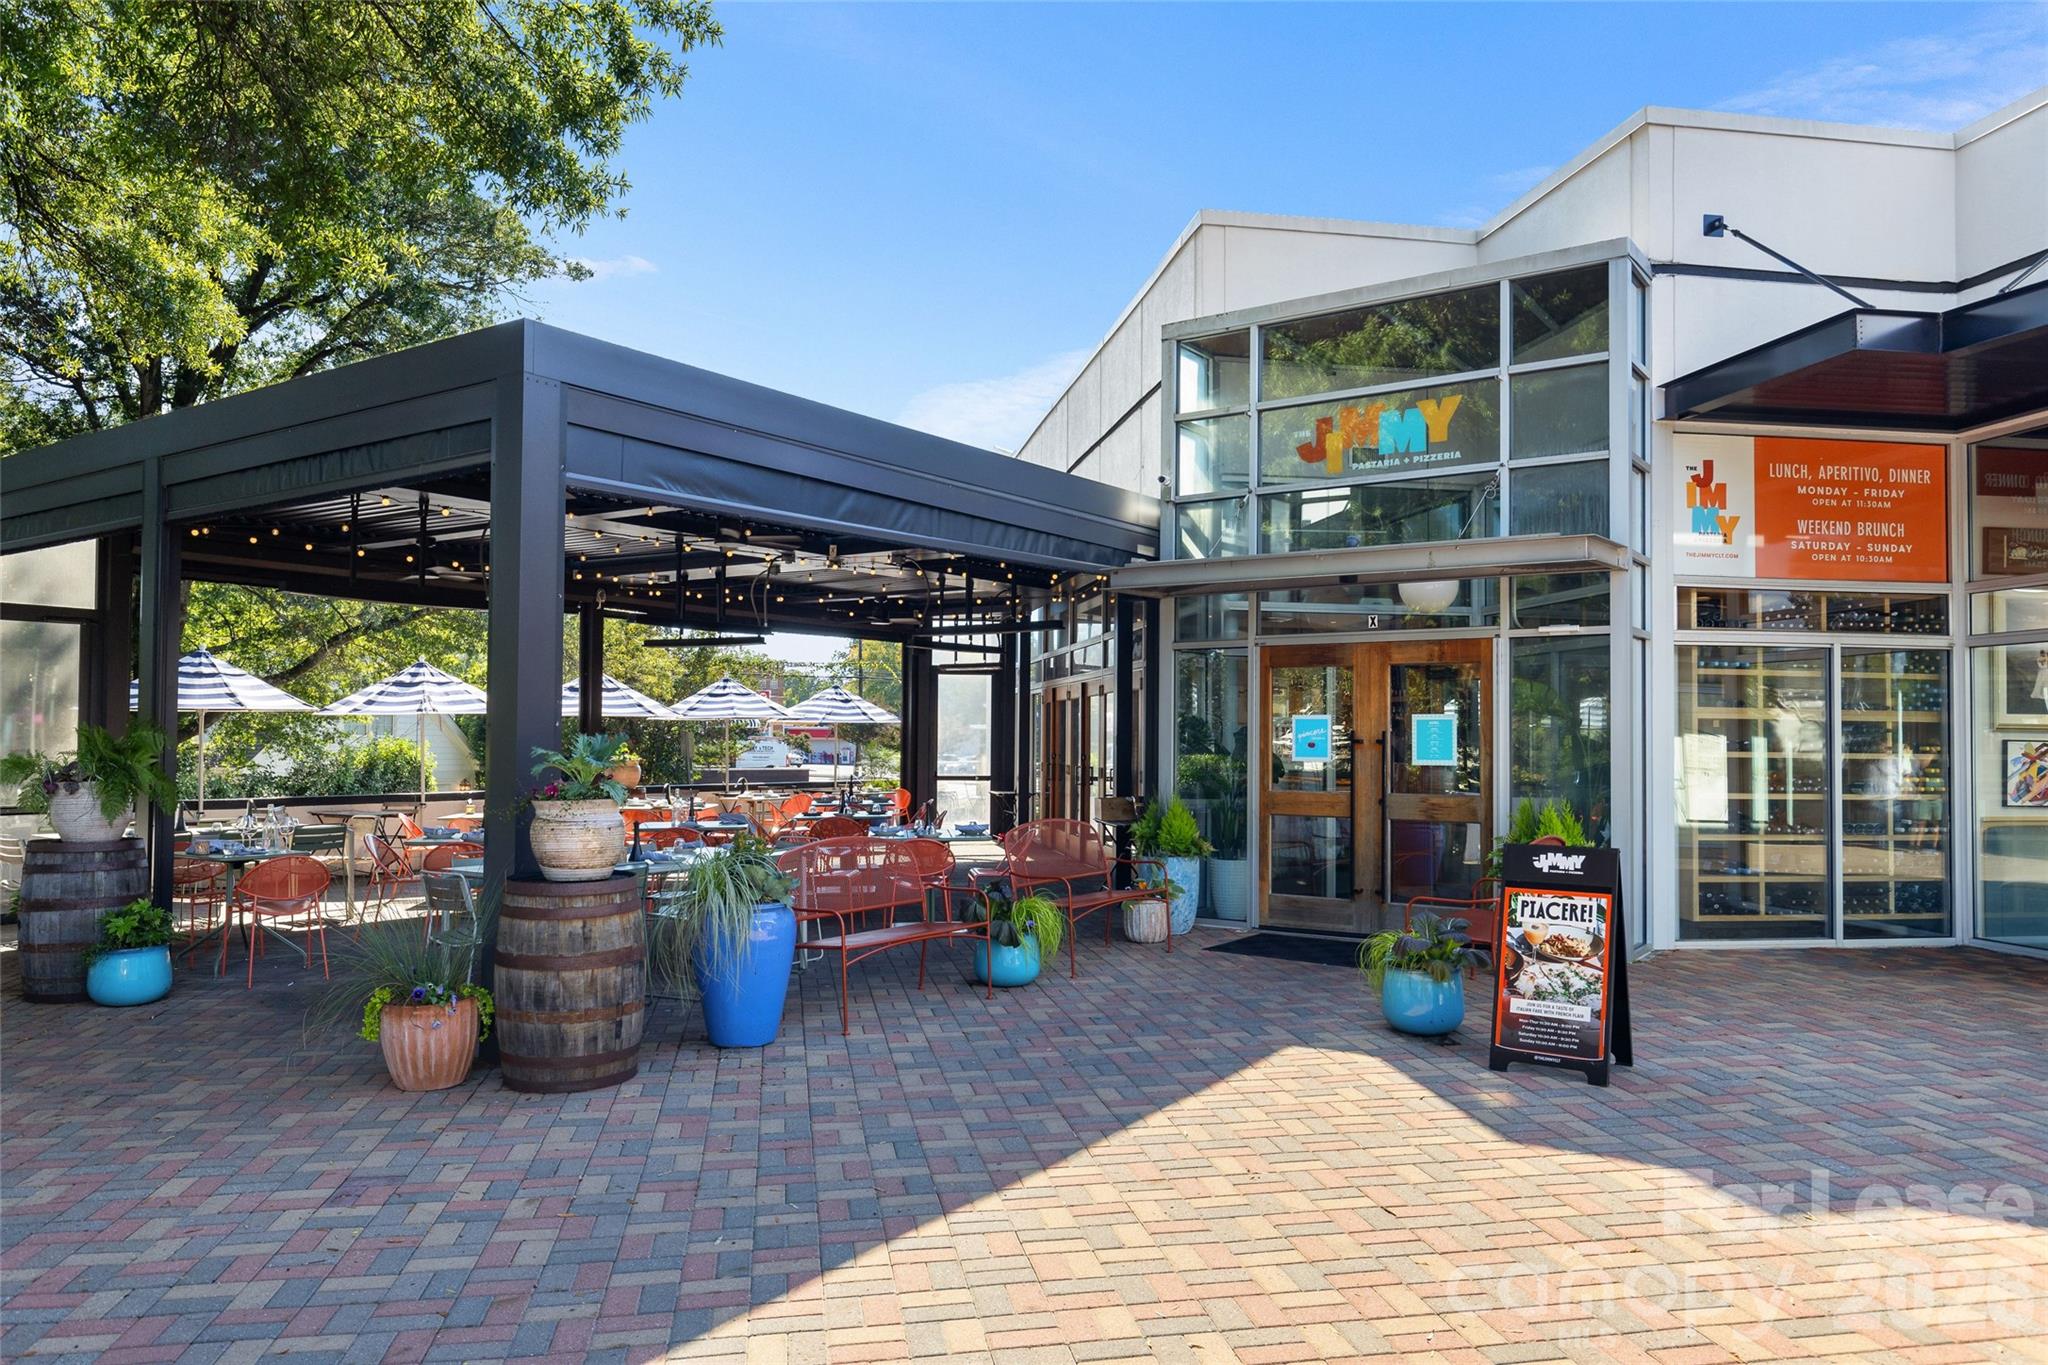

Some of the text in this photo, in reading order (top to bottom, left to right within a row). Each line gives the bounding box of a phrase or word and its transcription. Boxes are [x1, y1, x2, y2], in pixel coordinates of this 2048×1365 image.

[1296, 394, 1463, 475] JIMMY
[1352, 458, 1400, 470] PASTARIA
[1413, 450, 1461, 463] PIZZERIA
[1769, 463, 1931, 484] LUNCH, APERITIVO, DINNER
[1797, 485, 1848, 496] MONDAY
[1864, 488, 1905, 498] FRIDAY
[1812, 498, 1891, 508] OPEN AT 11:30AM
[1797, 519, 1905, 538] WEEKEND BRUNCH
[1791, 541, 1851, 551] SATURDAY
[1867, 543, 1913, 553] SUNDAY
[1841, 554, 1852, 562] AT
[1856, 555, 1893, 563] 10:30AM
[1533, 852, 1586, 872] JIMMY
[1519, 899, 1594, 924] PIACERE!
